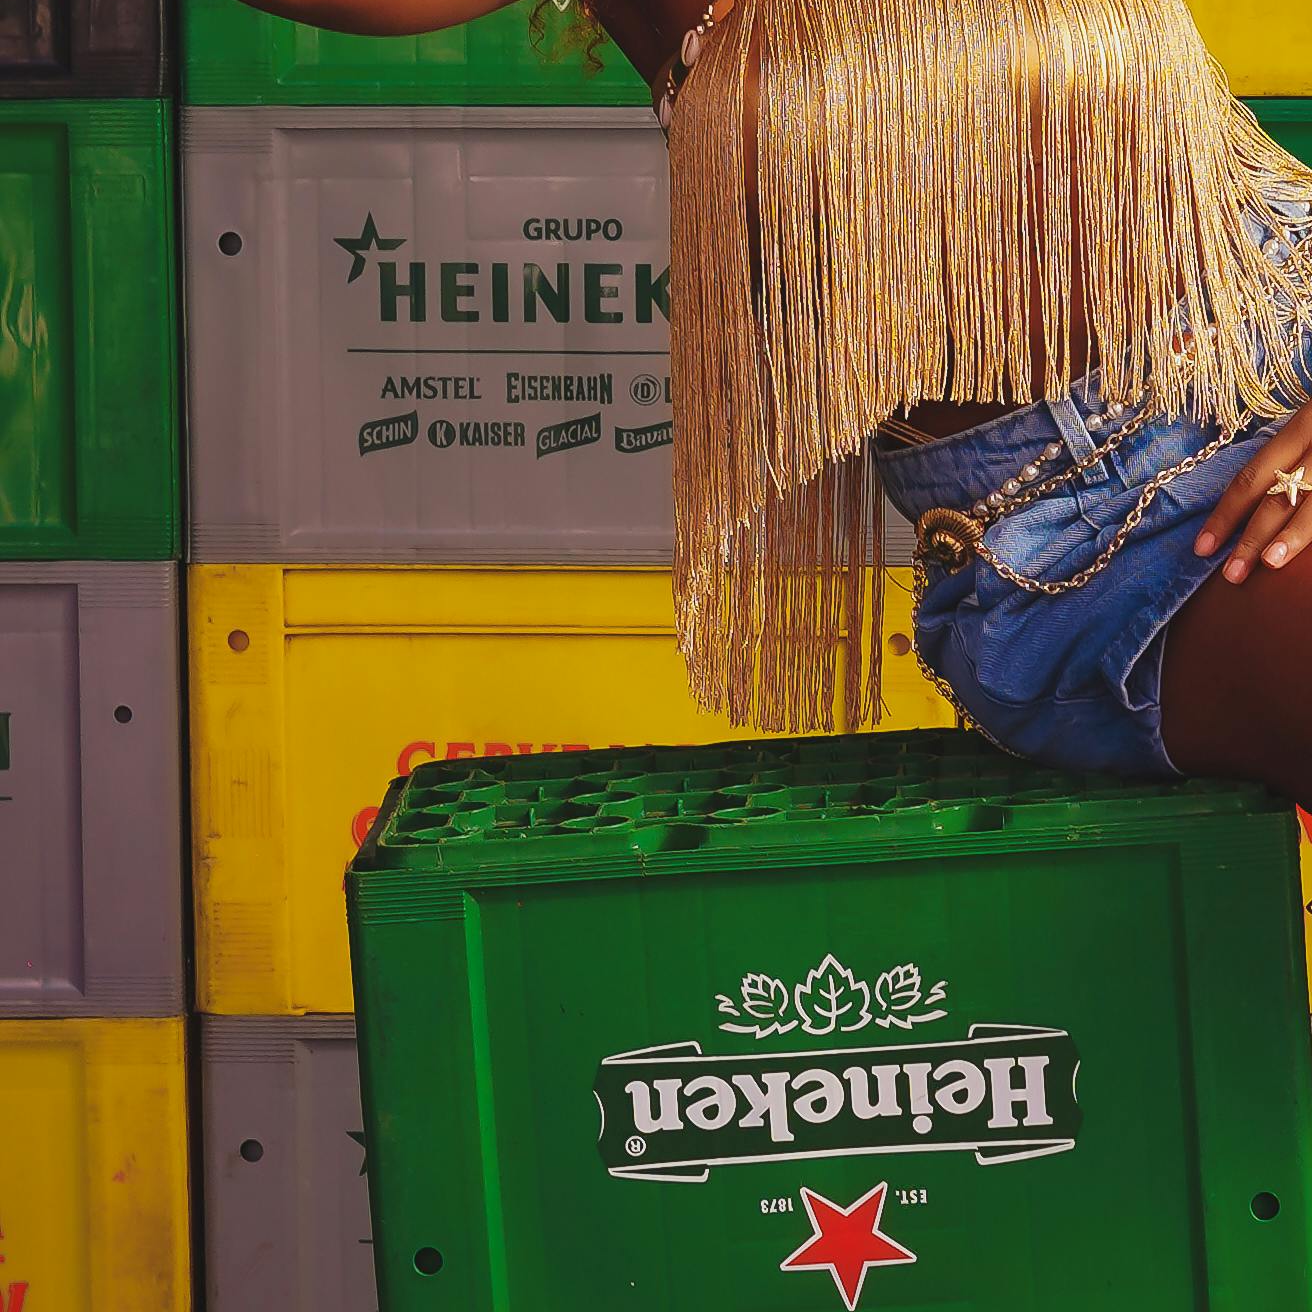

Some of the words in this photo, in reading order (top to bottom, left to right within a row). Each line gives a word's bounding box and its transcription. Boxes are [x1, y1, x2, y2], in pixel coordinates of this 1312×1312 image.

[523, 218, 623, 240] GRUPO
[380, 375, 482, 399] AMSTEL
[506, 372, 613, 404] EISENBAHN
[363, 420, 412, 446] SCHIN
[459, 422, 525, 446] KAISER
[539, 420, 599, 449] GLACIAL
[760, 1198, 793, 1214] 1873
[895, 1190, 928, 1205] EST.
